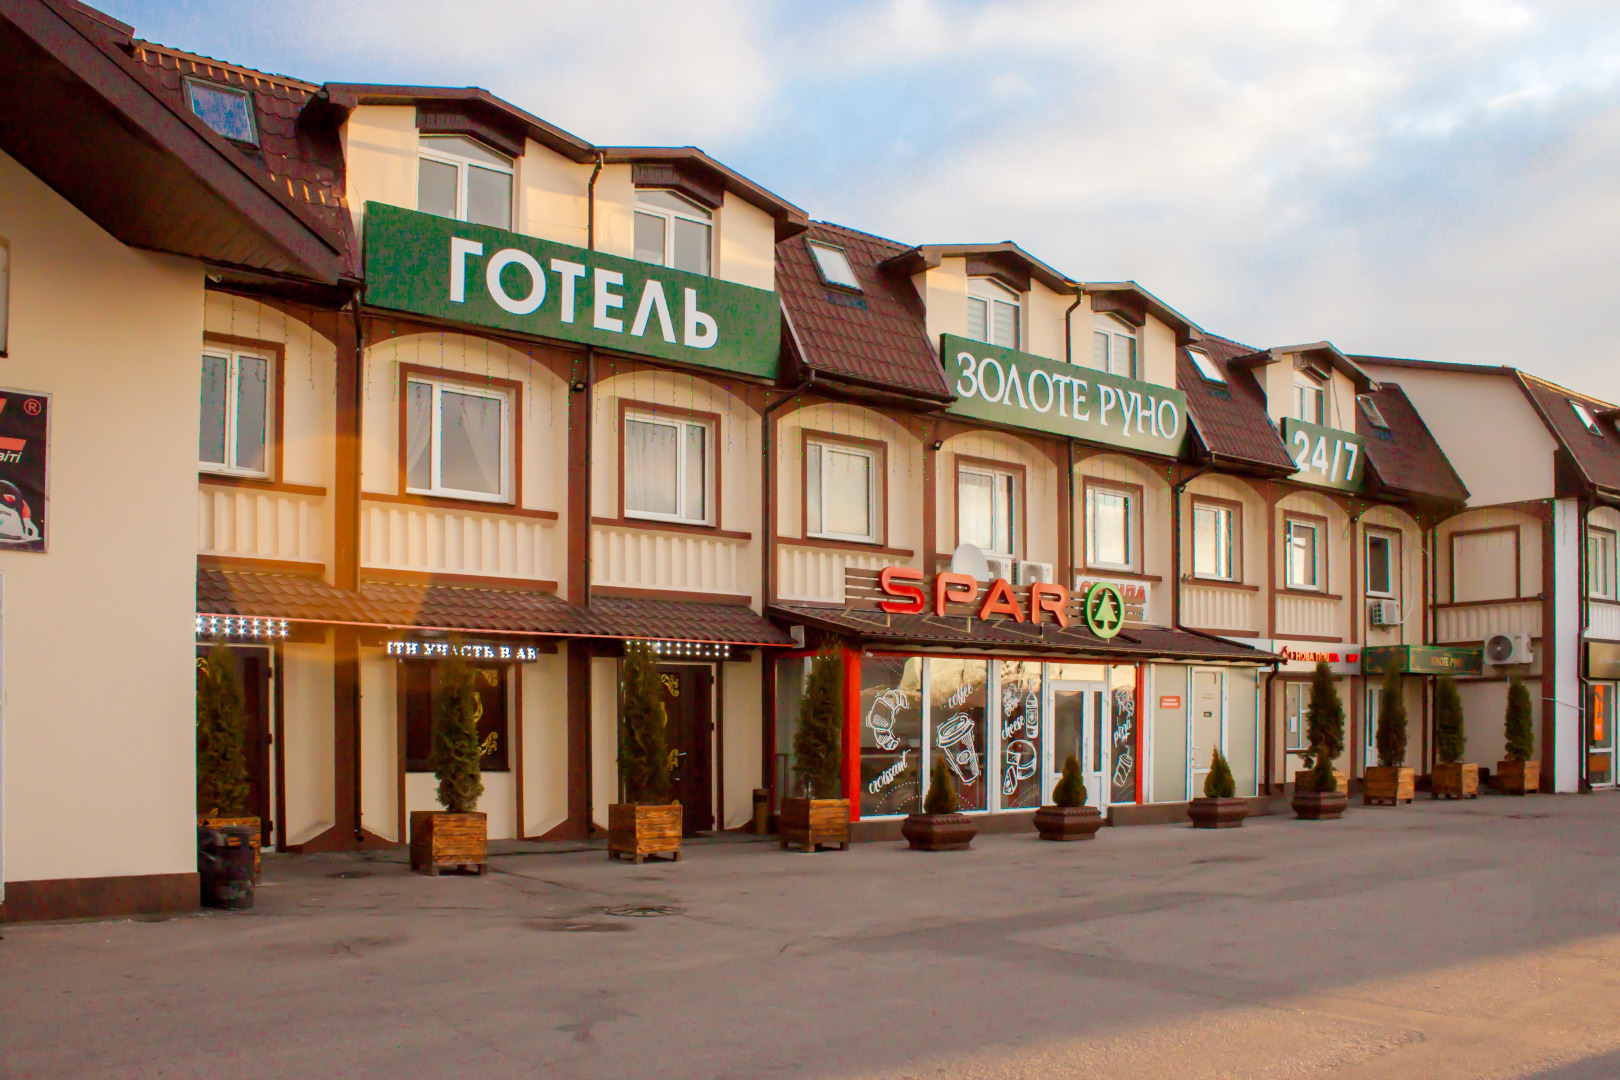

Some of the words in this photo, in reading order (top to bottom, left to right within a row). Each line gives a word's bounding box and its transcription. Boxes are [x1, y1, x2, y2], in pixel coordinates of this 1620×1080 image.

[450, 236, 719, 349] ГОТЕЛЬ
[956, 352, 1090, 421] ЗОЛОТЕ
[1097, 384, 1179, 440] РУНО
[1293, 430, 1358, 482] 24/7
[881, 567, 1068, 627] SPAR
[1296, 652, 1316, 661] НОВА
[948, 683, 973, 708] coffee
[1001, 715, 1025, 740] cheese
[869, 749, 911, 794] croissant
